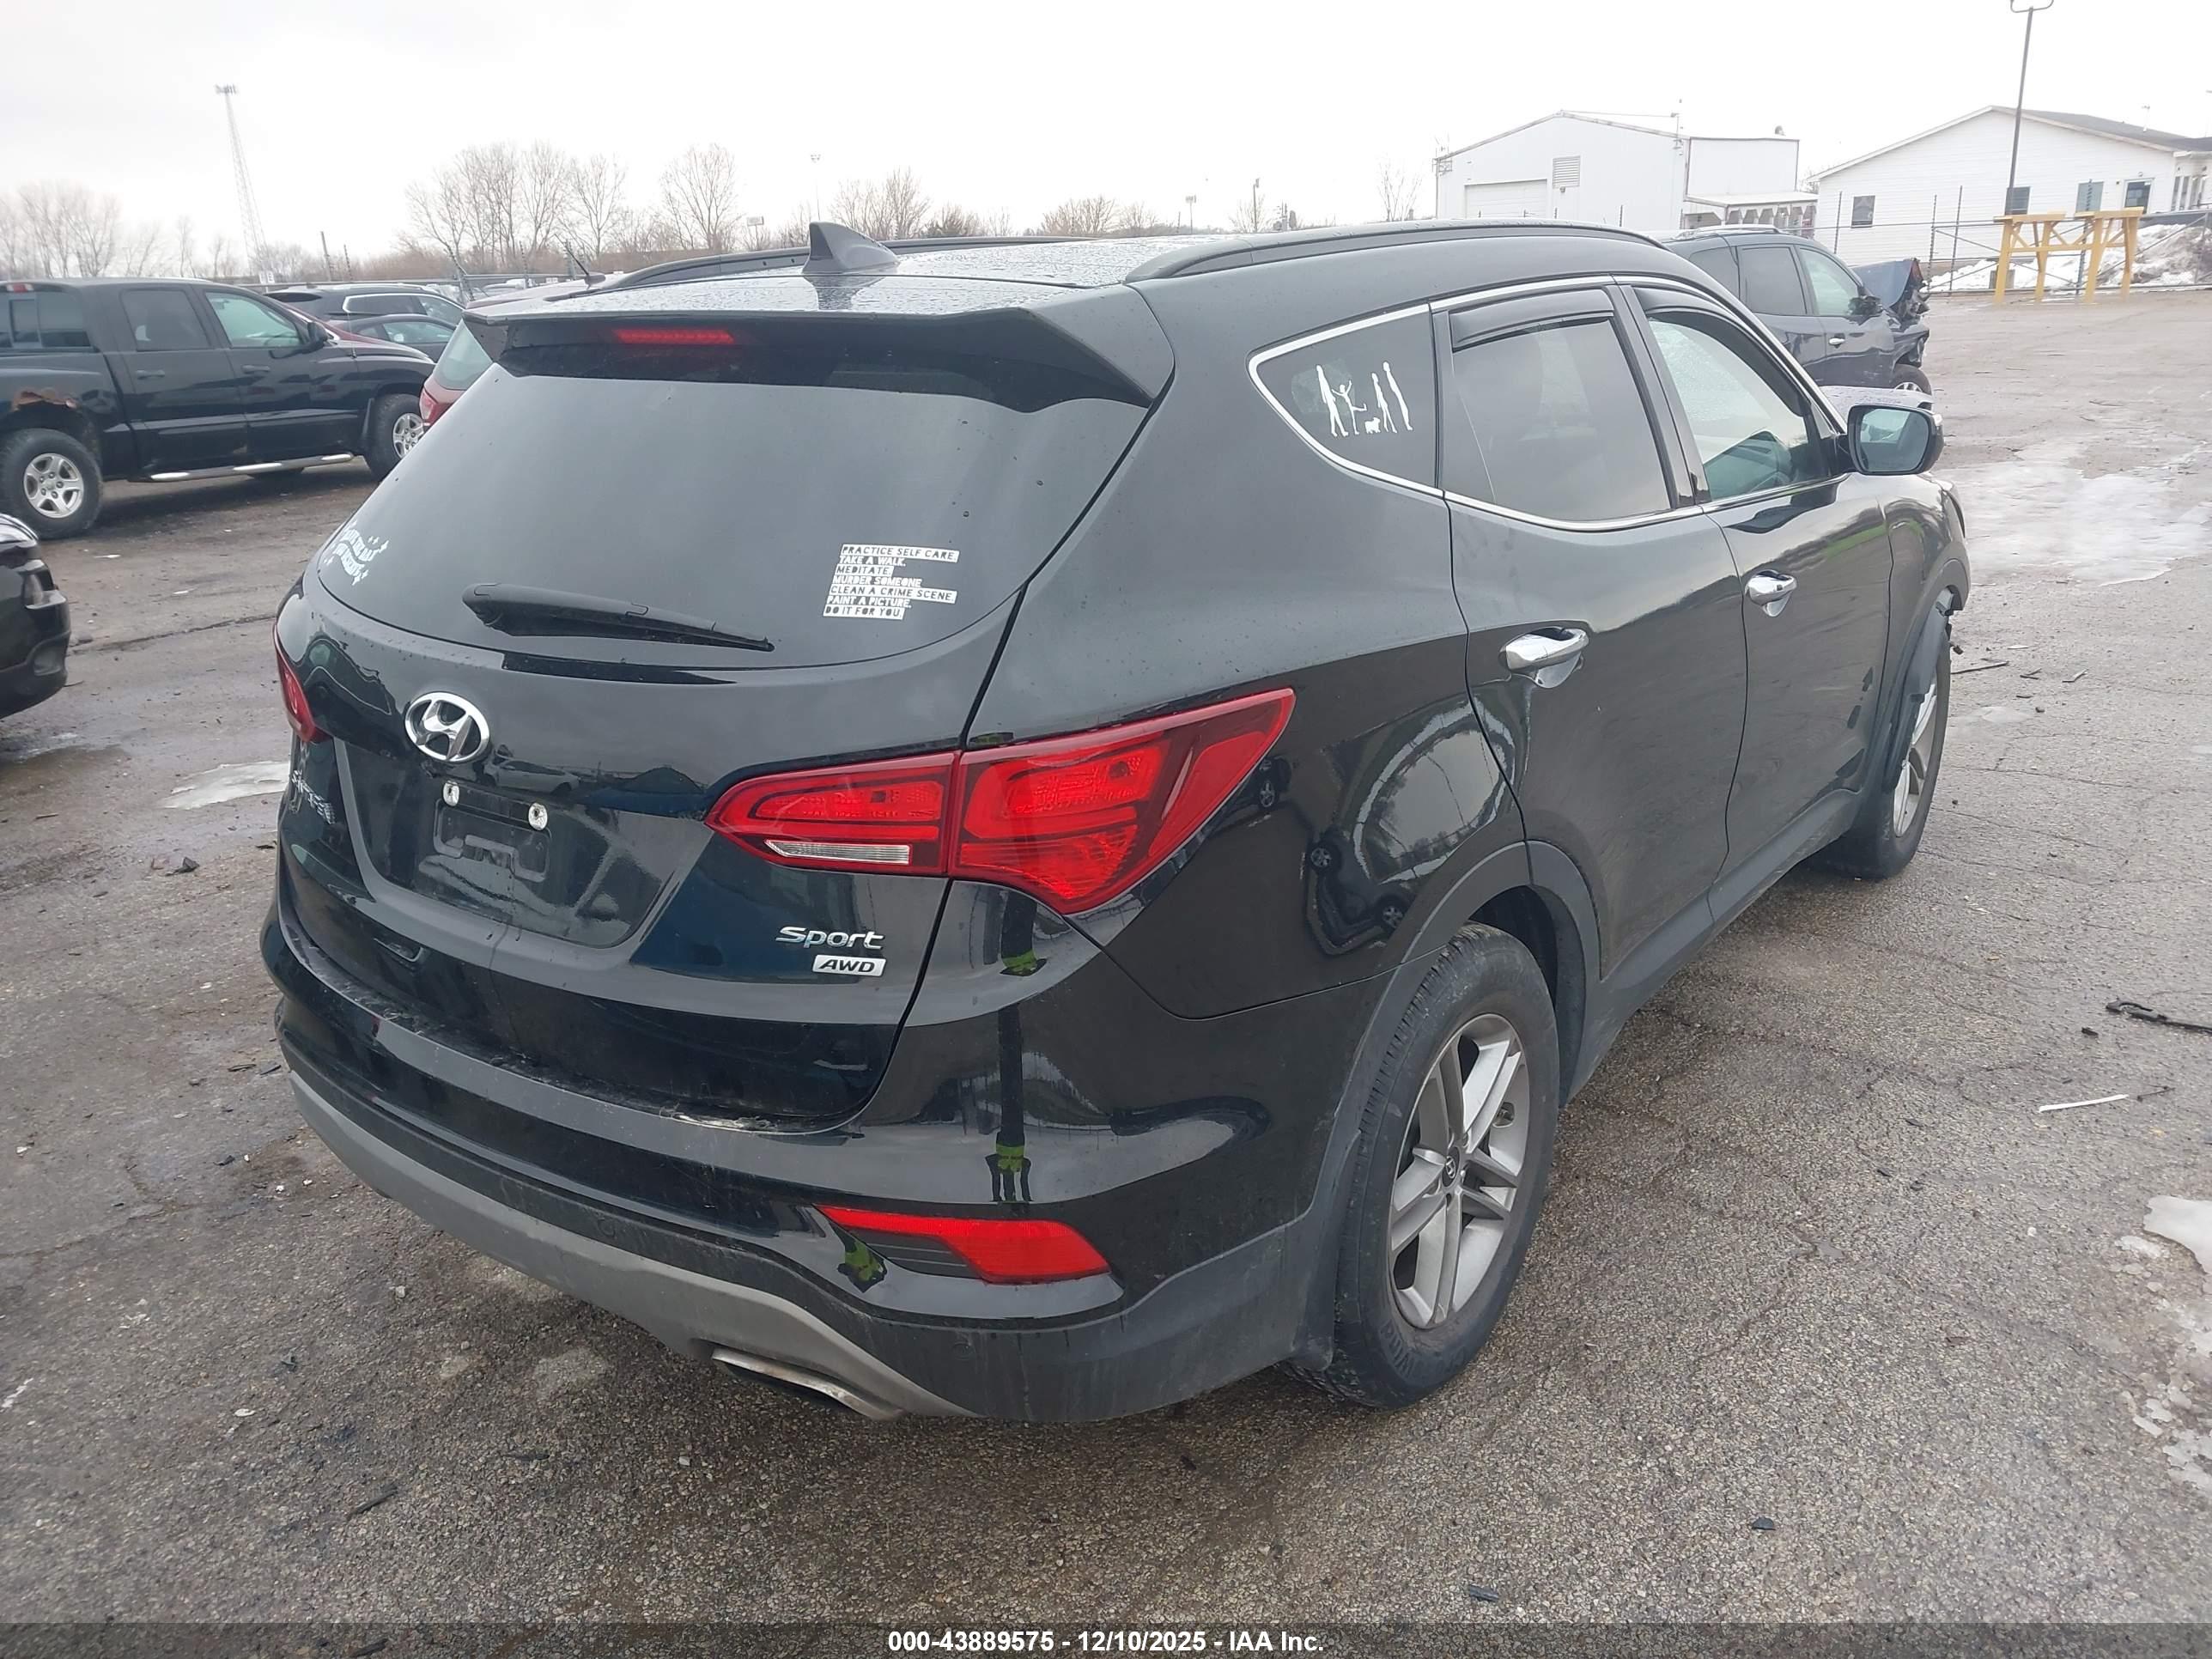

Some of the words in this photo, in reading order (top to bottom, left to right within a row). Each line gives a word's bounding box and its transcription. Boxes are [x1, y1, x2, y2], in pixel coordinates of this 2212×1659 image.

[842, 545, 894, 556] PRACTICE
[896, 547, 922, 557] SELF
[925, 550, 957, 561] CARE.
[839, 556, 863, 565] TAKE
[865, 556, 874, 565] A
[878, 557, 907, 567] WALK.
[836, 565, 892, 575] MEDITATE.
[832, 575, 872, 585] MURDER
[874, 576, 923, 586] SOMEONE
[830, 586, 866, 594] CLEAN
[868, 586, 877, 595] A
[880, 588, 913, 598] CRIME
[826, 595, 859, 605] PAINT
[859, 597, 867, 605] A
[842, 606, 852, 615] IT
[854, 606, 875, 616] FOR
[775, 927, 885, 951] Sport
[818, 958, 876, 973] AWD
